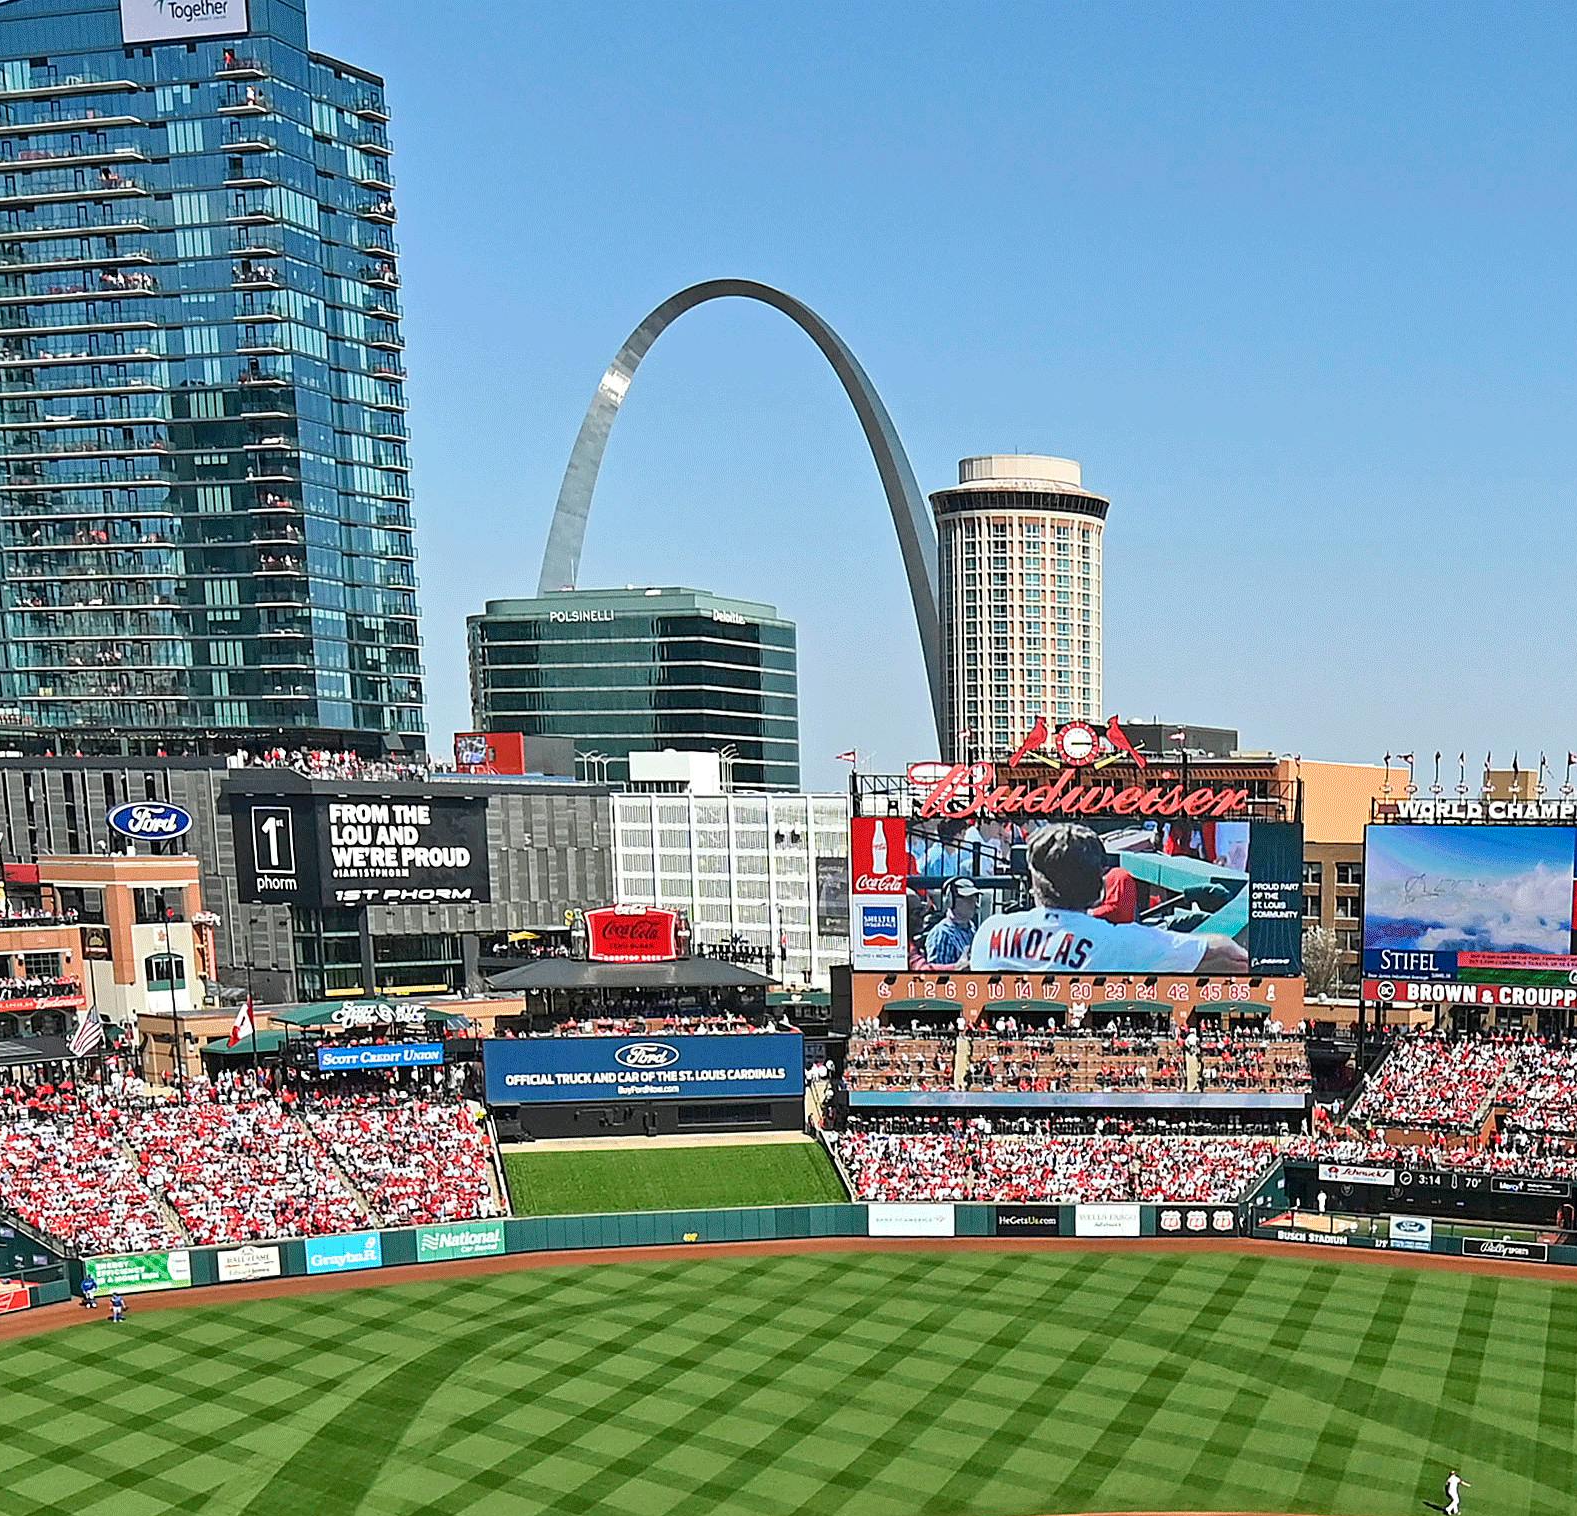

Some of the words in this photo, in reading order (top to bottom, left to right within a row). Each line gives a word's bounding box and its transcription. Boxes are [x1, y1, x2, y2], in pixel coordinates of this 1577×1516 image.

[168, 0, 228, 22] Together
[550, 610, 614, 622] POLSINELLI
[907, 762, 1249, 819] Budweiser
[329, 803, 390, 825] FROM
[392, 805, 431, 825] THE
[1397, 801, 1483, 820] WORLD
[128, 806, 177, 833] Ford
[331, 825, 372, 846] LOU
[376, 825, 419, 846] AND
[331, 847, 399, 868] WE'RE
[401, 847, 471, 868] PROUD
[256, 875, 298, 893] phorm
[1252, 883, 1279, 892] PROUD
[1280, 883, 1300, 892] PART
[335, 889, 379, 902] 1ST
[383, 888, 472, 901] PHORM
[1252, 892, 1263, 900] OF
[1264, 892, 1279, 900] THE
[1263, 901, 1287, 910] LOUIS
[1252, 911, 1299, 919] COMMUNITY
[989, 927, 1093, 970] MIKOLAS
[1380, 950, 1440, 971] STIFEL
[907, 983, 915, 999] 1
[924, 983, 936, 999] 2
[944, 983, 957, 999] 6
[966, 983, 978, 999] 9
[987, 983, 1005, 999] 10
[1014, 983, 1033, 999] 14
[1042, 983, 1061, 999] 17
[1070, 983, 1092, 999] 20
[1105, 983, 1126, 999] 23
[1135, 983, 1157, 999] 24
[1167, 983, 1189, 999] 42
[1200, 983, 1222, 999] 45
[1229, 983, 1250, 999] 85
[1407, 983, 1477, 1003] BROWN
[1483, 989, 1494, 1003] &
[34, 996, 85, 1010] Budweiser
[322, 1053, 358, 1066] SCOTT
[360, 1051, 401, 1064] CREDIT
[403, 1050, 440, 1062] UNION
[626, 1046, 668, 1064] Ford
[505, 1074, 554, 1086] OFFICIAL
[555, 1073, 592, 1085] TRUCK
[593, 1073, 616, 1084] AND
[617, 1072, 639, 1084] CAR
[640, 1072, 655, 1083] OF
[656, 1071, 677, 1082] THE
[678, 1071, 695, 1082] ST.
[695, 1070, 722, 1082] LOUIS
[725, 1068, 786, 1081] CARDINALS
[1341, 1168, 1392, 1180] Schnucks
[1418, 1174, 1441, 1185] 3:14
[998, 1214, 1056, 1227] HeGetsUs.com
[1400, 1221, 1421, 1232] Ford
[438, 1229, 502, 1249] National
[1277, 1231, 1307, 1242] BUSCH
[1308, 1232, 1348, 1245] STADIUM
[1480, 1241, 1509, 1257] Bally
[95, 1260, 130, 1271] ENERGY
[96, 1266, 145, 1278] EFFICIENCY
